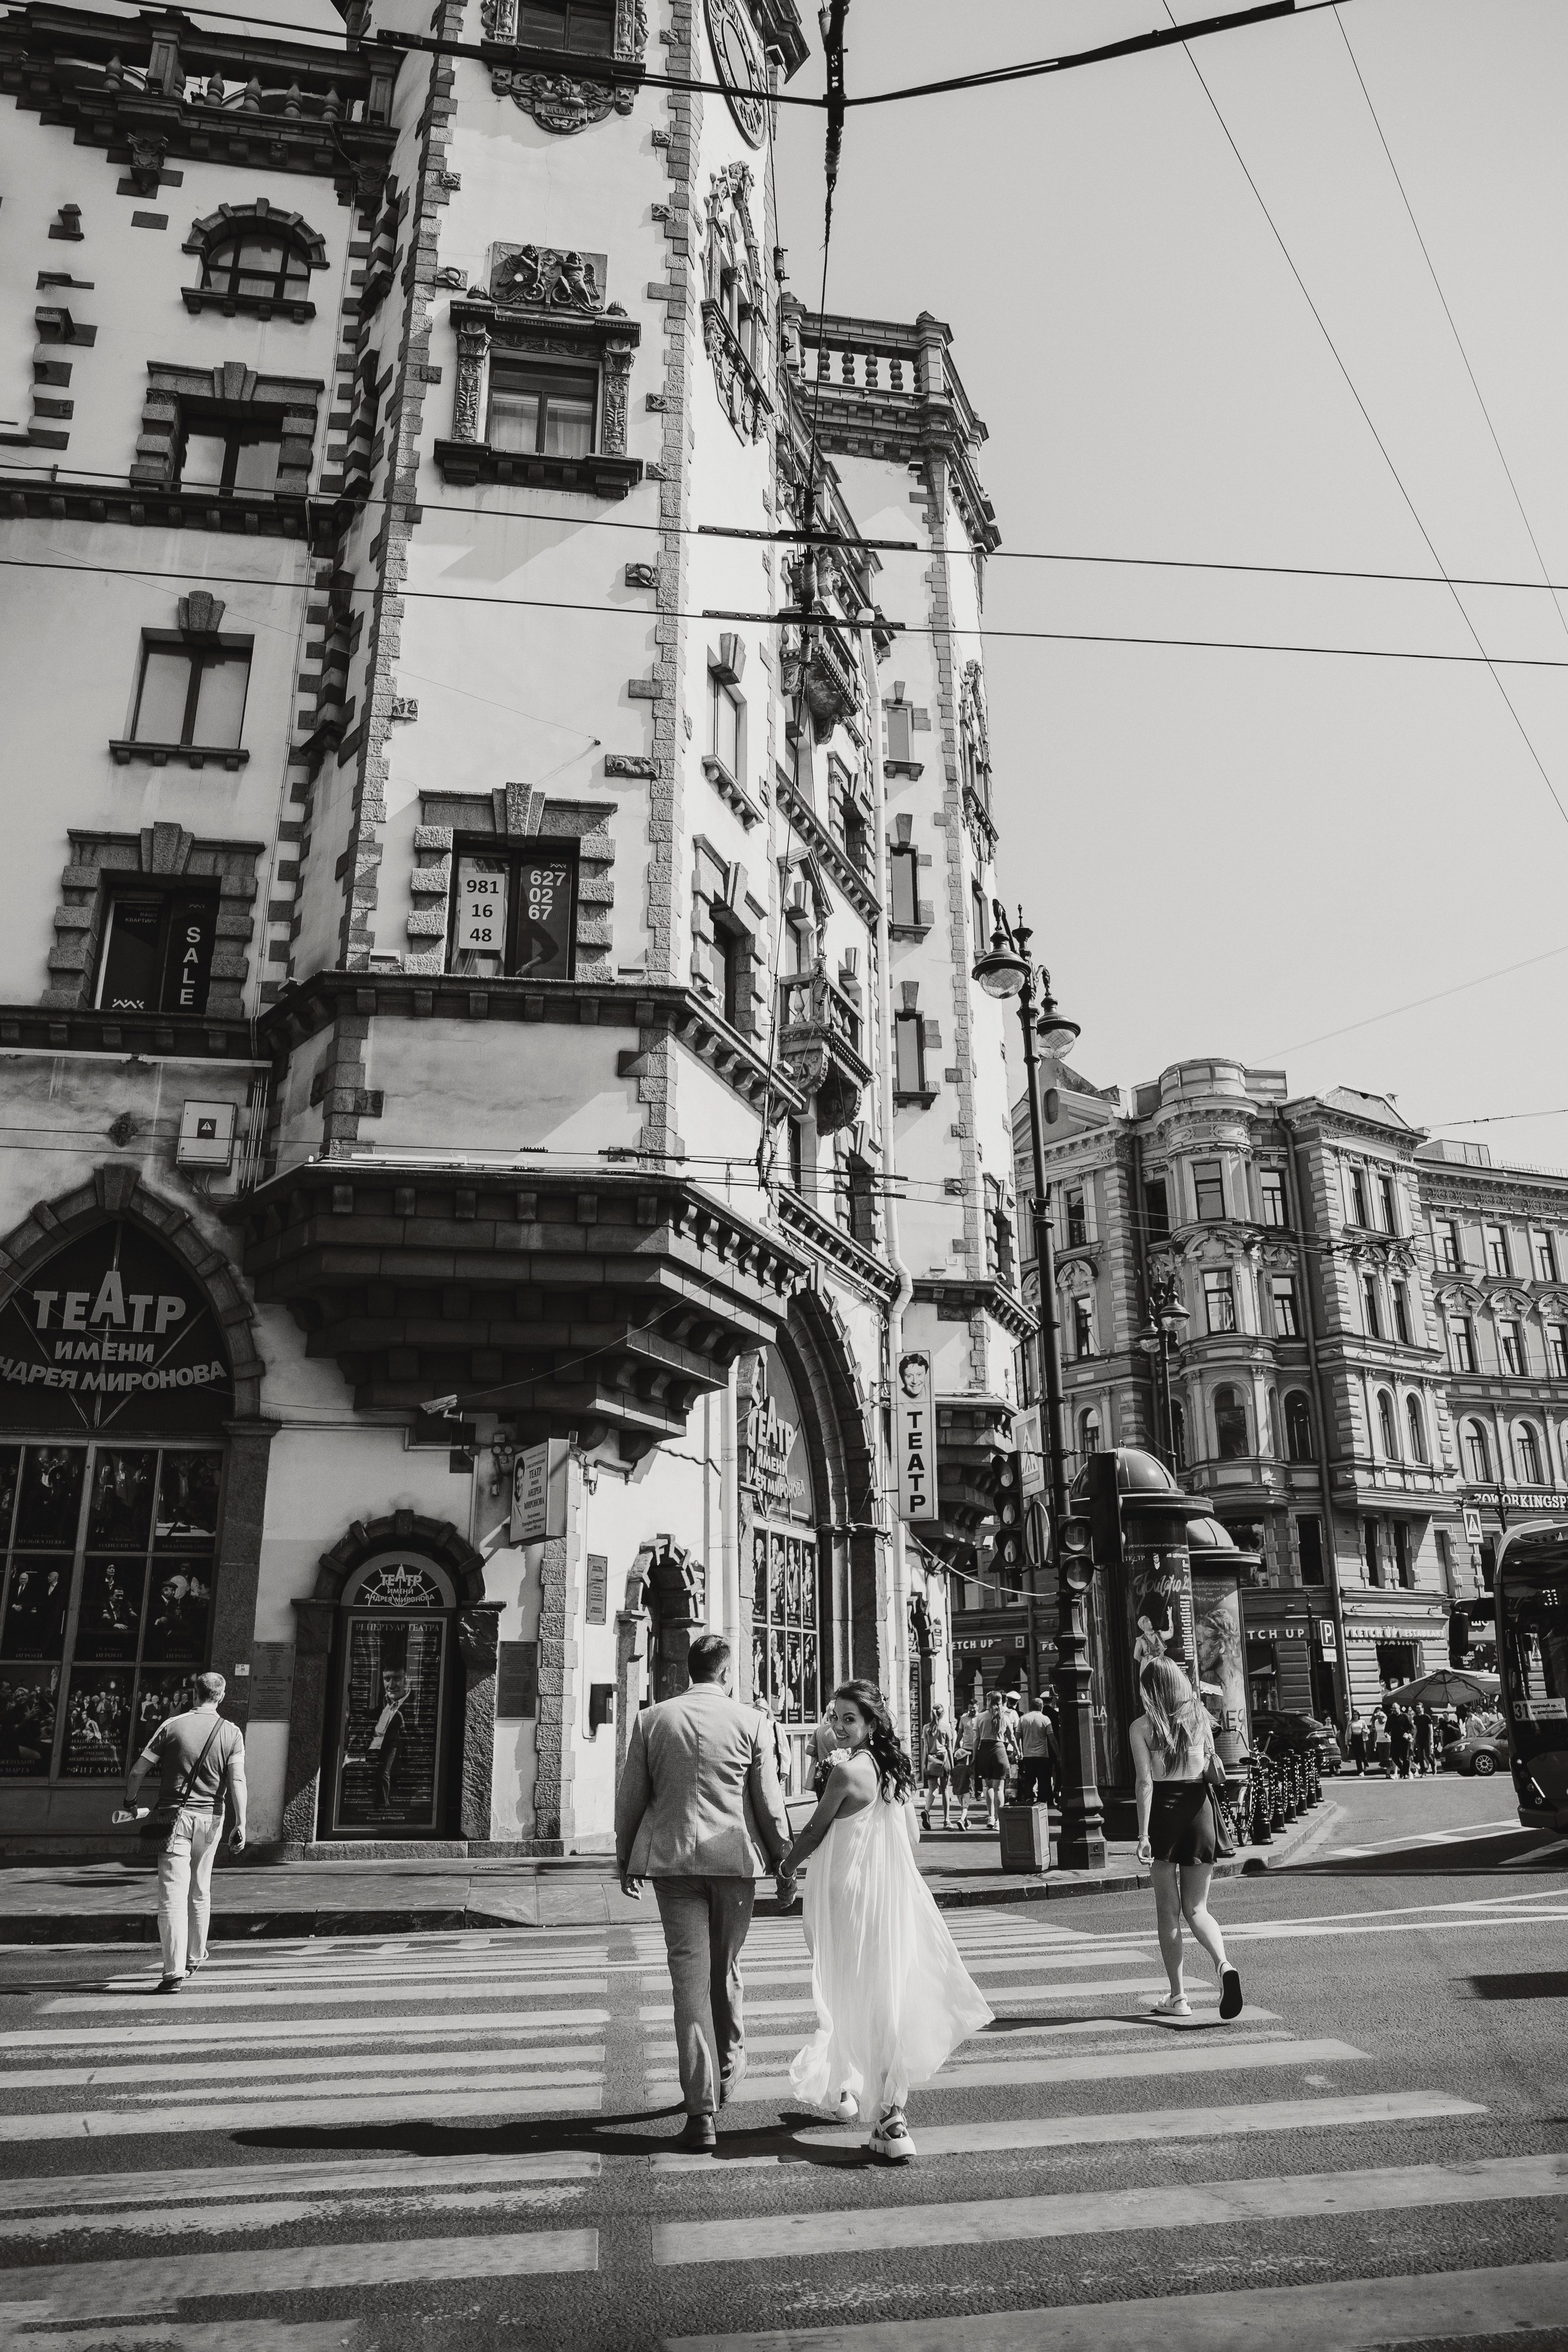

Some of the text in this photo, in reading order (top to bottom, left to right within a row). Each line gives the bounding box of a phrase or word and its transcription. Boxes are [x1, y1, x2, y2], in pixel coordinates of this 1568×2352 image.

[546, 106, 576, 116] MCMXV
[530, 870, 567, 886] 627
[467, 880, 499, 894] 981
[529, 888, 553, 903] 02
[472, 903, 493, 918] 16
[528, 904, 552, 920] 67
[469, 928, 492, 942] 48
[179, 927, 201, 1005] SALE
[33, 1270, 186, 1334] ТЕАТР
[55, 1341, 155, 1362] ИМЕНИ
[80, 1360, 227, 1392] МИРОНОВА
[747, 1395, 795, 1456] ТЕАТР
[756, 1447, 788, 1477] ИМЕНИ
[907, 1411, 926, 1513] ТЕАТР
[529, 1466, 543, 1479] ТЕАТР
[528, 1486, 542, 1498] АНДРЕЯ
[767, 1479, 805, 1499] МИРОНОВА
[524, 1497, 545, 1510] МИРОНОВА
[380, 1566, 423, 1586] ТЕАТР
[365, 1594, 435, 1603] АНДРЕЯ МИРОНОВА
[409, 1623, 440, 1632] ТЕАТРА
[1247, 1628, 1305, 1640] TCH UP
[1324, 1623, 1332, 1643] P
[1351, 1629, 1384, 1638] KETCH
[980, 1639, 994, 1648] UP
[1514, 1703, 1529, 1719] 31
